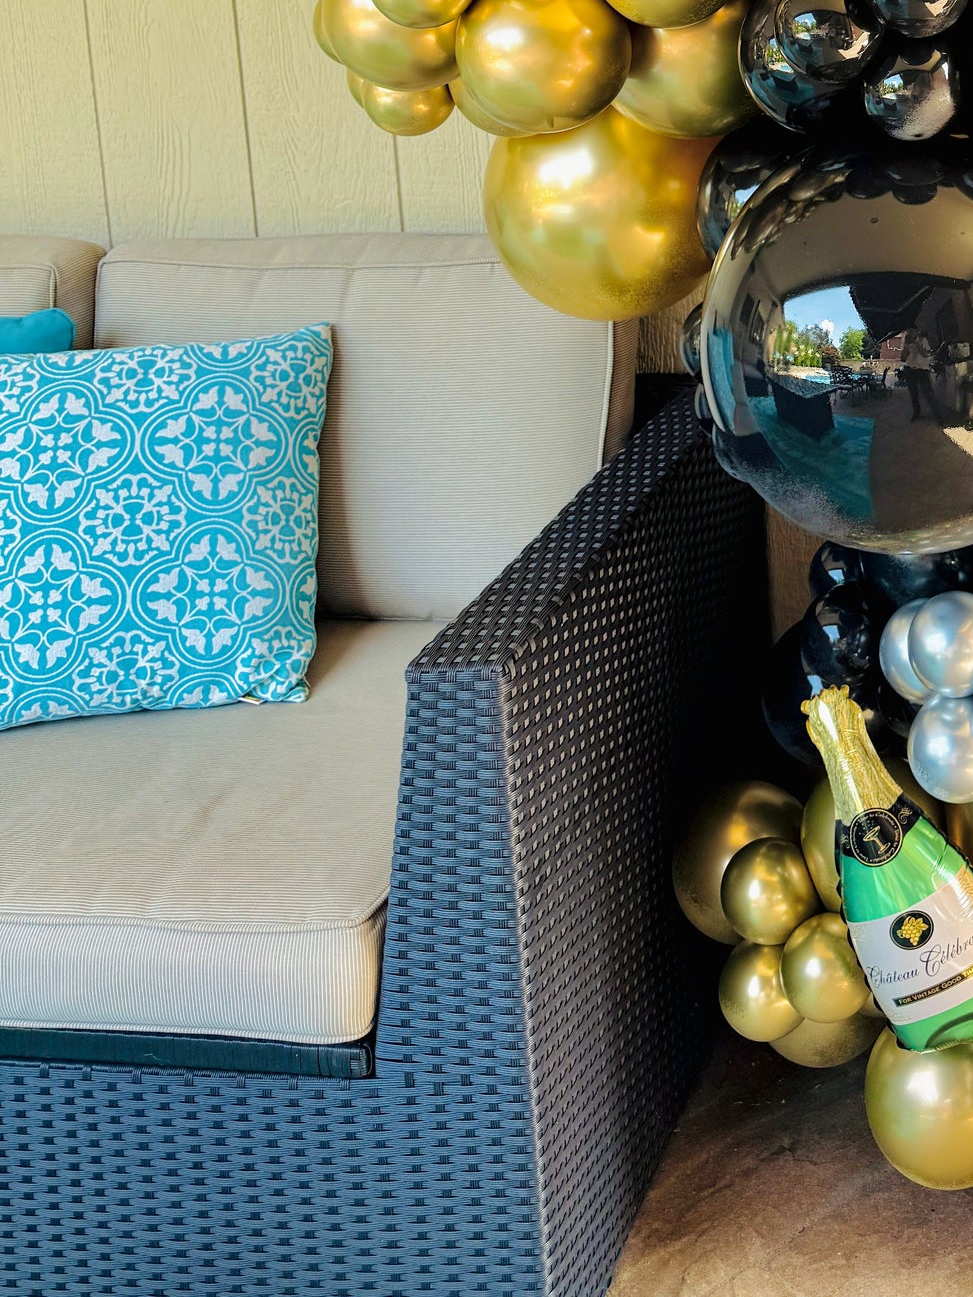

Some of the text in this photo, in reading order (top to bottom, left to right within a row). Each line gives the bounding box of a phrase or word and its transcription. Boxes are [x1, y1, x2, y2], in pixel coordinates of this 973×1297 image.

[866, 965, 919, 989] Château
[898, 996, 913, 1005] FOR
[912, 987, 941, 1001] VINTAGE
[941, 976, 962, 989] GOOD
